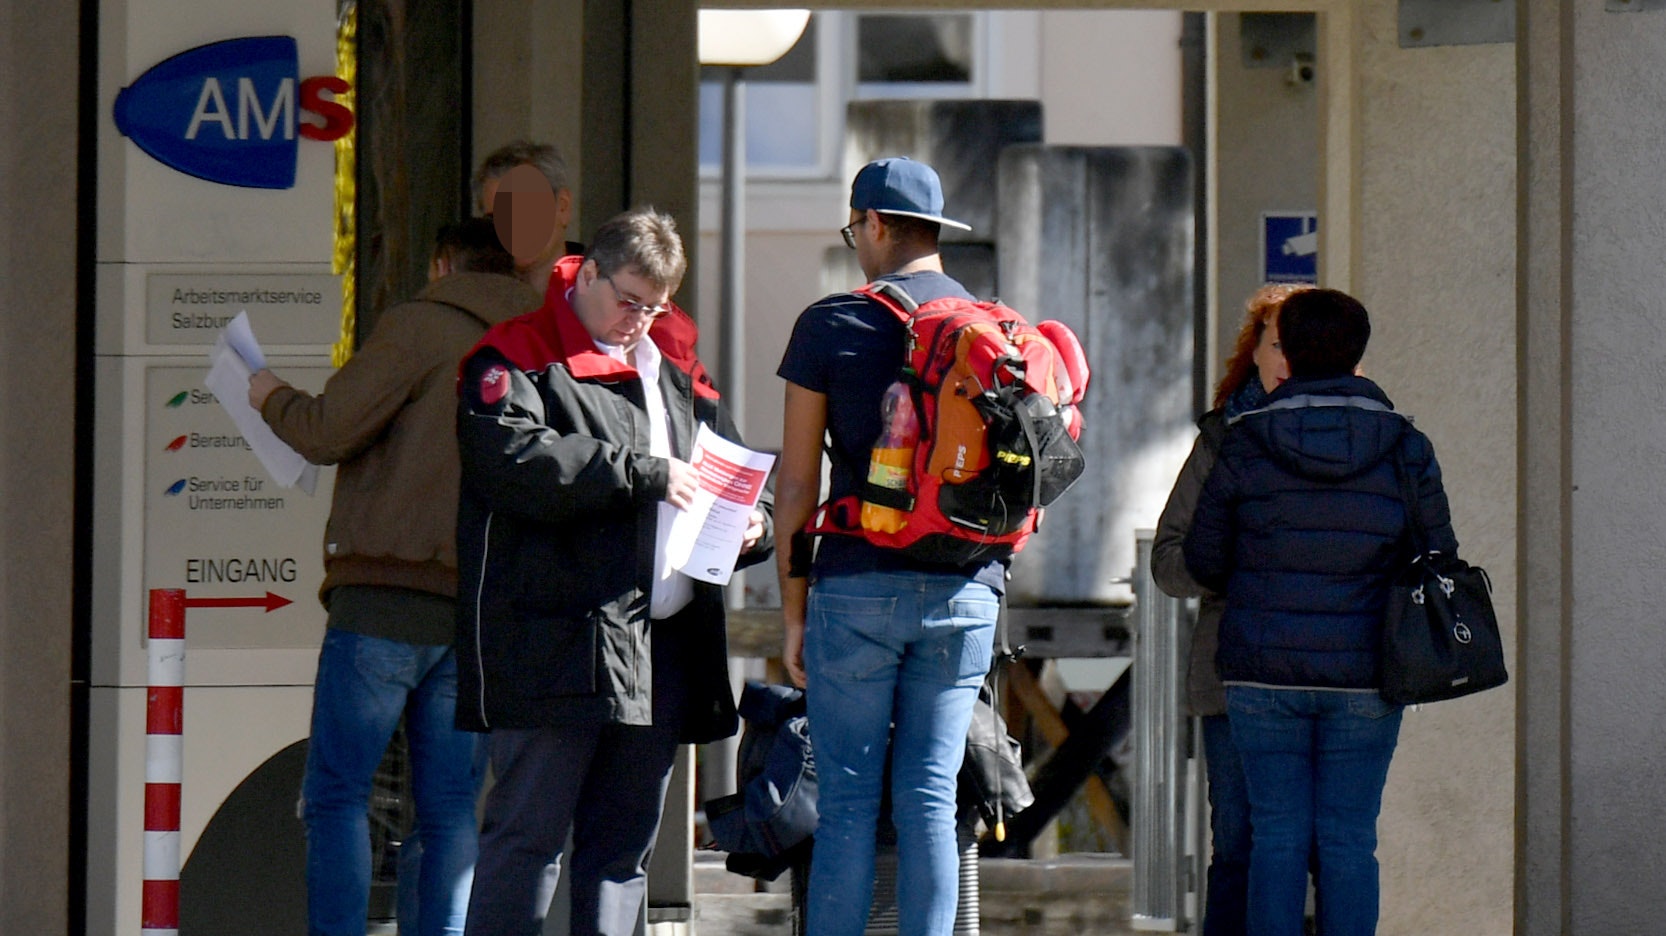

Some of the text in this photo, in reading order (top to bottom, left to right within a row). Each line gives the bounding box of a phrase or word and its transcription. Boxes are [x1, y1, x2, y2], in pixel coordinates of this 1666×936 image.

[184, 75, 355, 142] AMS
[172, 288, 322, 304] Arbeitsmarktservice
[172, 312, 235, 329] Salzbur
[996, 450, 1031, 466] PIEPS
[189, 477, 264, 491] Service für
[189, 496, 285, 510] Unternehmen
[186, 558, 297, 583] EINGANG
